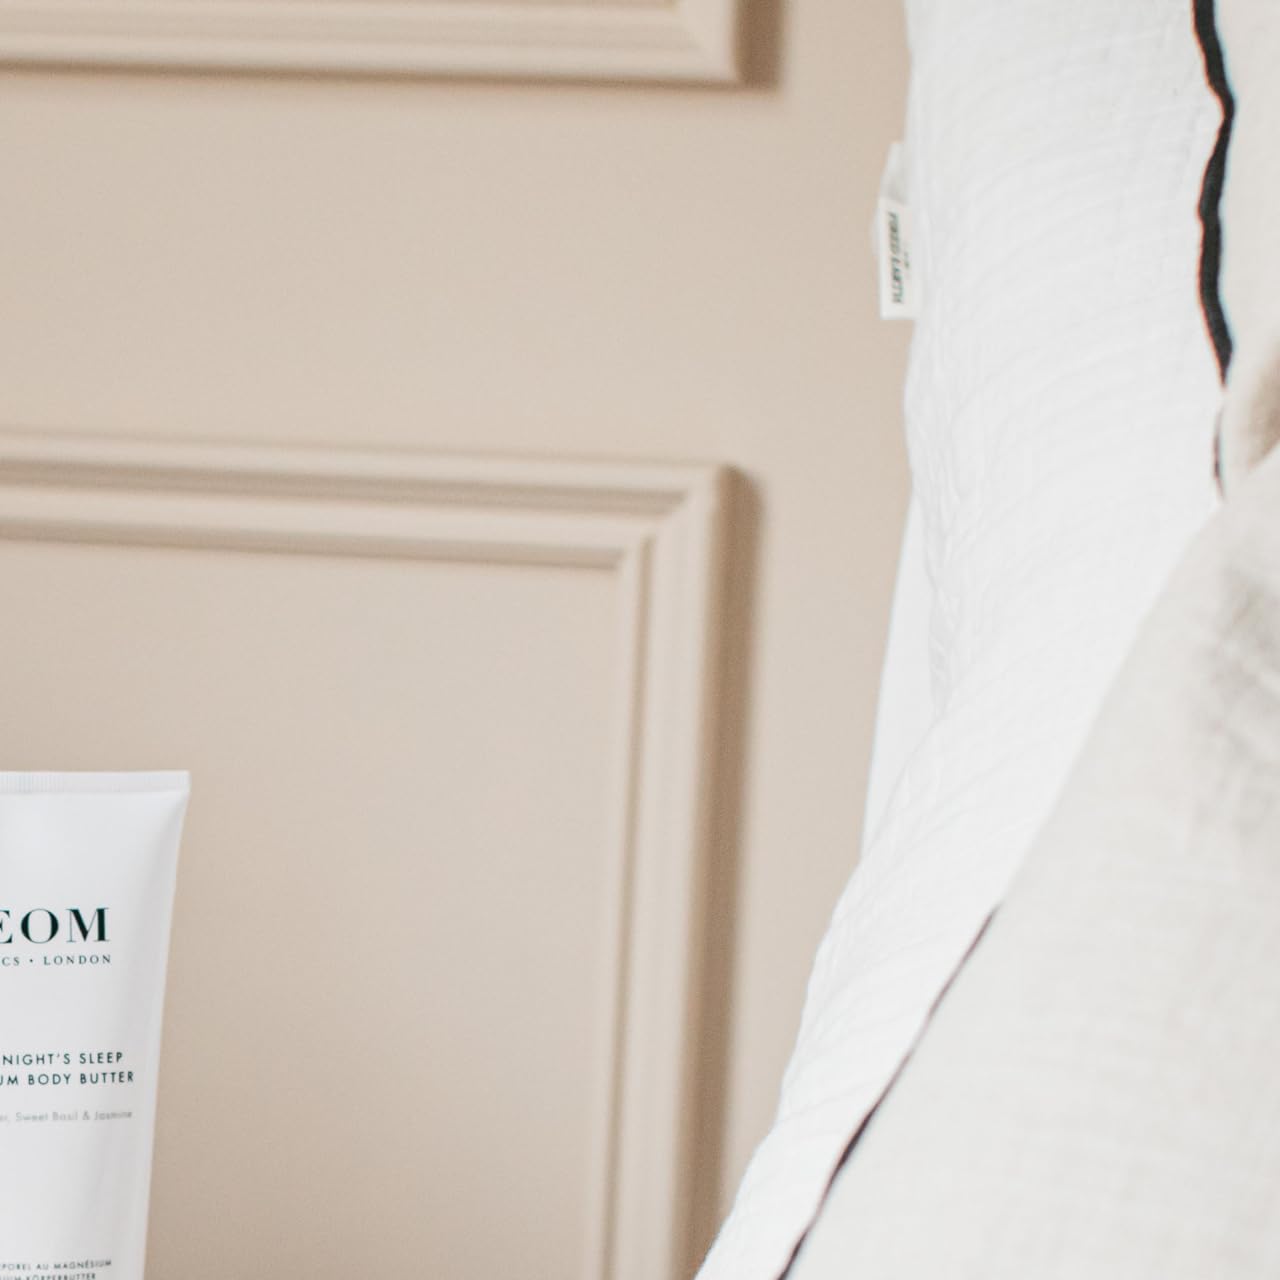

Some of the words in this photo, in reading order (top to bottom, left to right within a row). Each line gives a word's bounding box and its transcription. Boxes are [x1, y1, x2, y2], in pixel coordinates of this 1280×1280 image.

[43, 954, 112, 966] LONDON
[2, 1053, 71, 1066] NIGHT'S
[79, 1052, 124, 1064] SLEEP
[27, 1073, 71, 1086] BODY
[79, 1071, 135, 1085] BUTTER
[36, 1261, 49, 1270] AU
